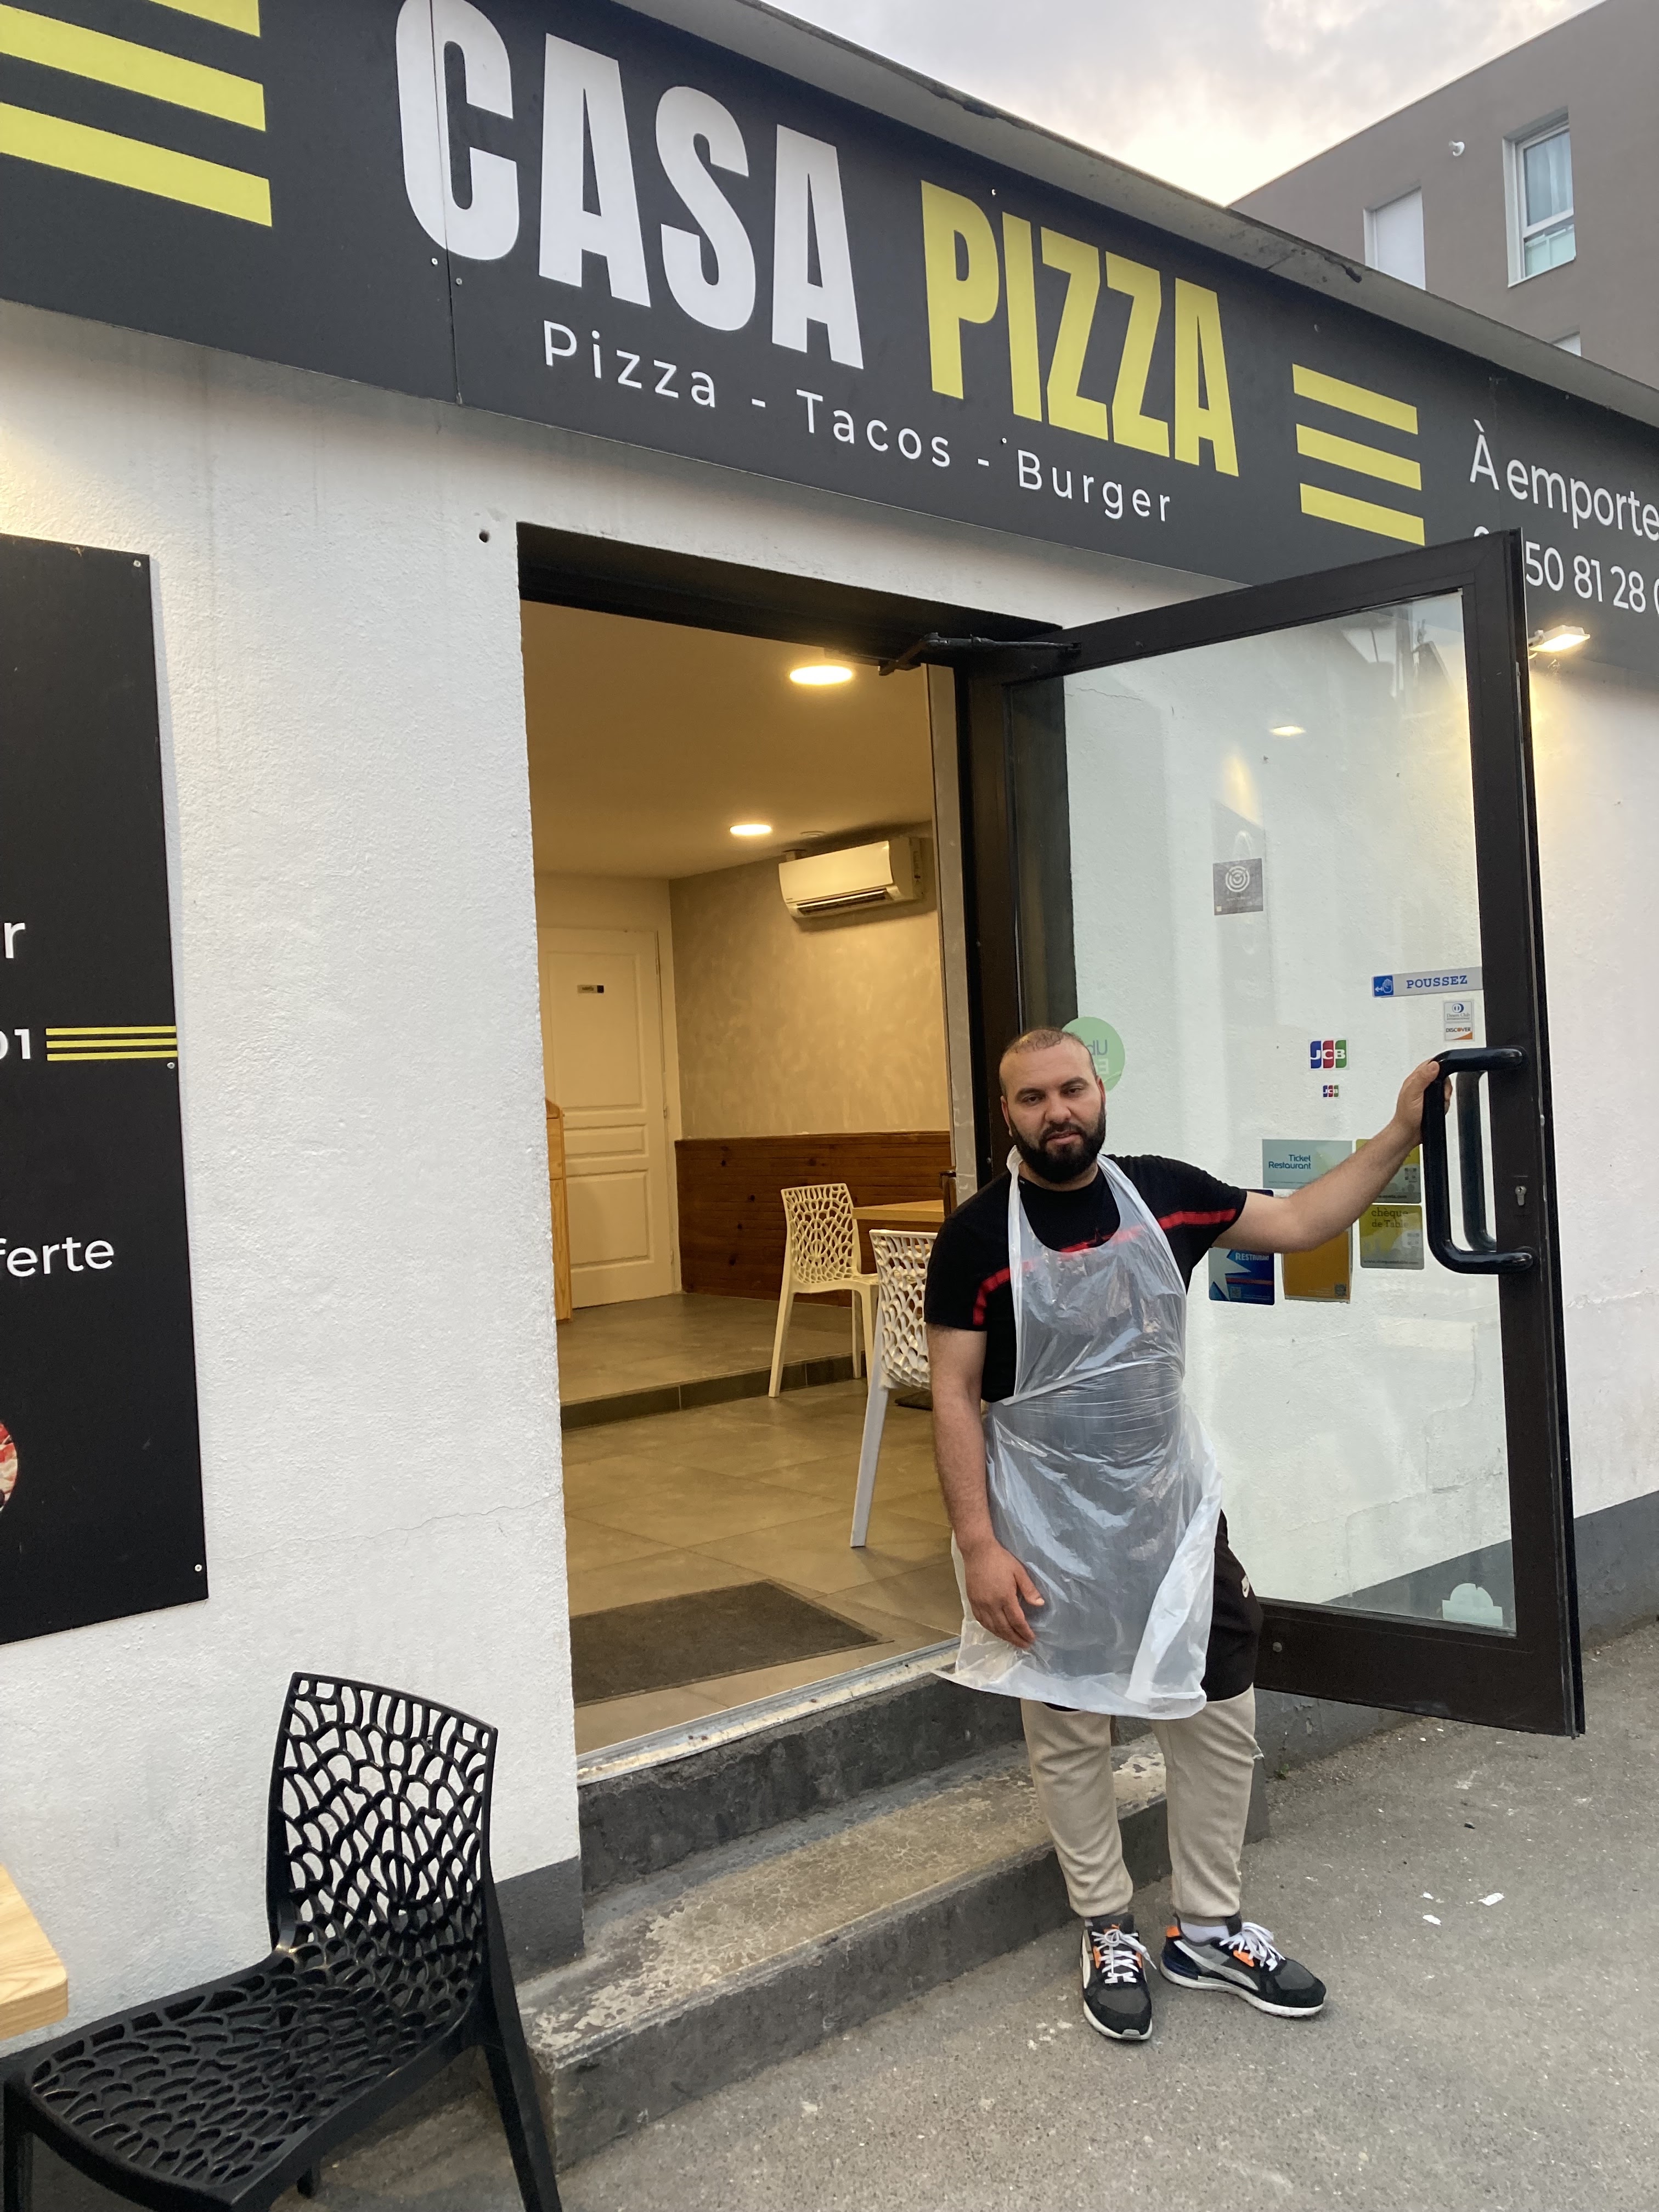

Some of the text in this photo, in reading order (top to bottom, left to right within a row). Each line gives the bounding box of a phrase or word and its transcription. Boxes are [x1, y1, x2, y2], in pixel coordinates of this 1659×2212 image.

[395, 0, 1240, 477] CASA PIZZA
[544, 320, 716, 408] Pizza
[796, 389, 950, 467] Tacos
[1018, 449, 1171, 522] Burger
[1470, 419, 1659, 541] À emporte
[1526, 541, 1564, 591] 50
[1573, 555, 1603, 602] 81
[1610, 566, 1646, 613] 28
[1406, 975, 1468, 989] POUSSEZ
[1288, 1154, 1311, 1162] Ticket
[1268, 1161, 1311, 1170] Restaurant
[1371, 1207, 1408, 1219] chèque
[1372, 1220, 1409, 1228] de Table
